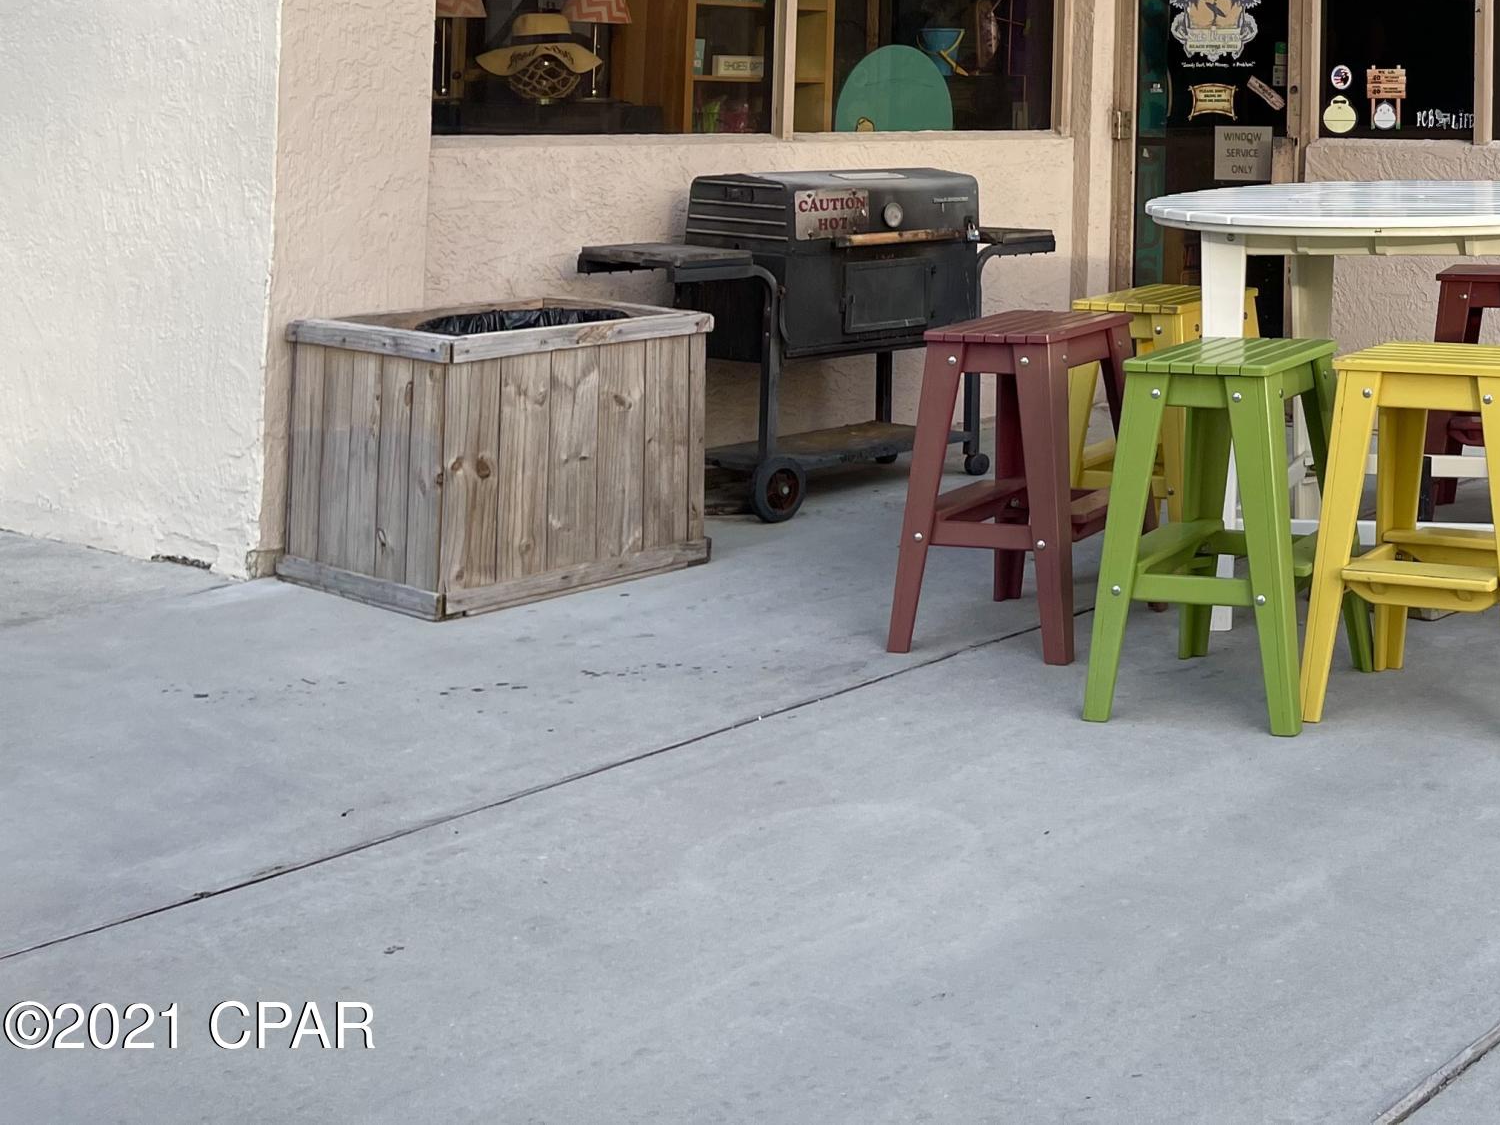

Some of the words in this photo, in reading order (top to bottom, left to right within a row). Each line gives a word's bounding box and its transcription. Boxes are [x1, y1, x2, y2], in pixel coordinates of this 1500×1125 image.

[1223, 132, 1262, 142] WINDOW
[1226, 148, 1259, 158] SERVICE
[1231, 164, 1253, 174] ONLY
[798, 196, 866, 213] CAUTION
[818, 217, 848, 231] HOT
